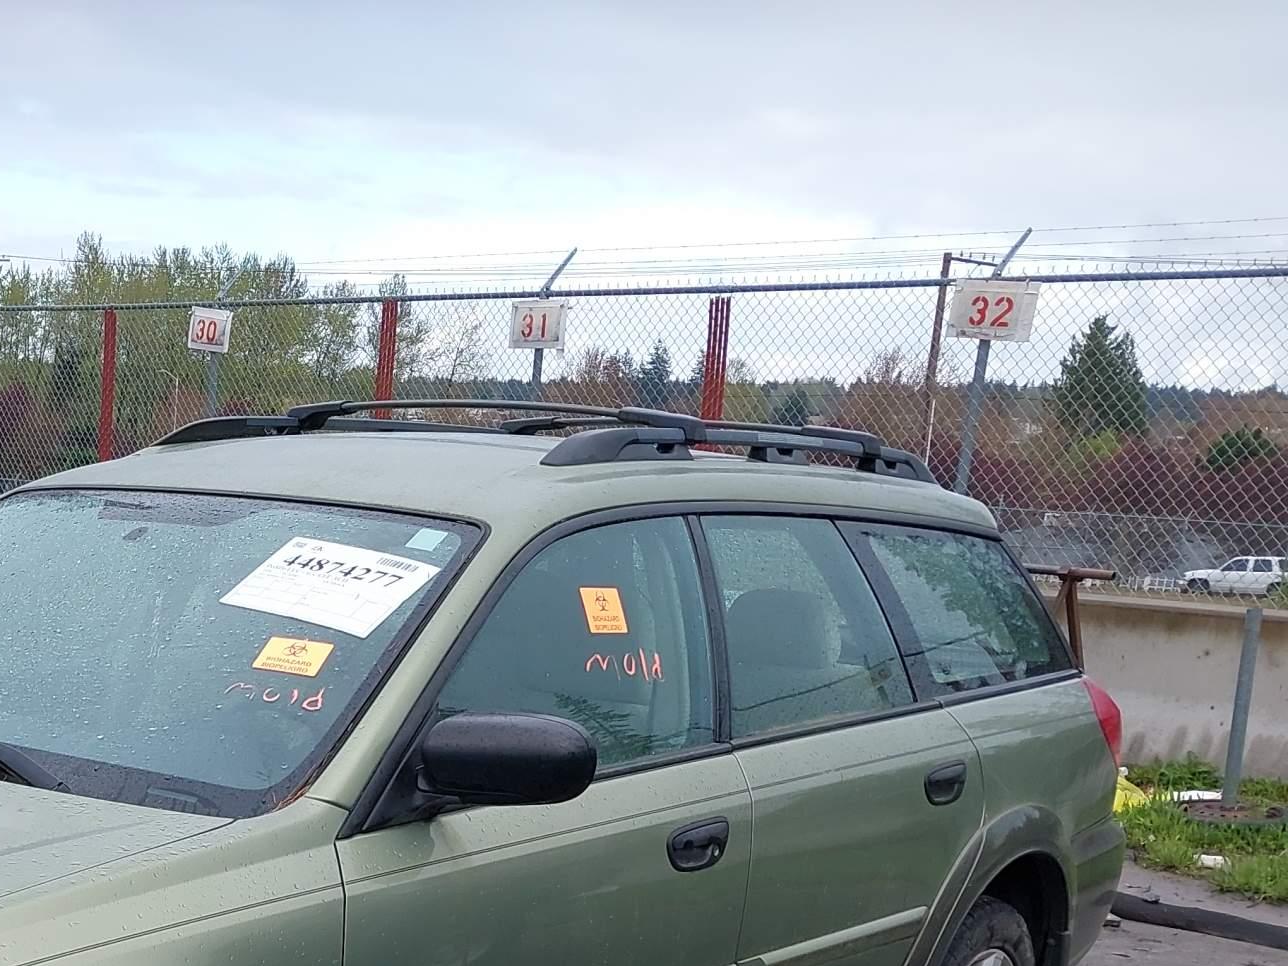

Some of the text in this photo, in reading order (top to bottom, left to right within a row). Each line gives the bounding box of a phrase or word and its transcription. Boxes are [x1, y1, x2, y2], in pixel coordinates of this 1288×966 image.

[968, 295, 1014, 327] 32
[196, 319, 217, 341] 30
[521, 312, 546, 338] 31
[283, 554, 404, 588] 44874277
[266, 655, 312, 668] BIOHAZARD
